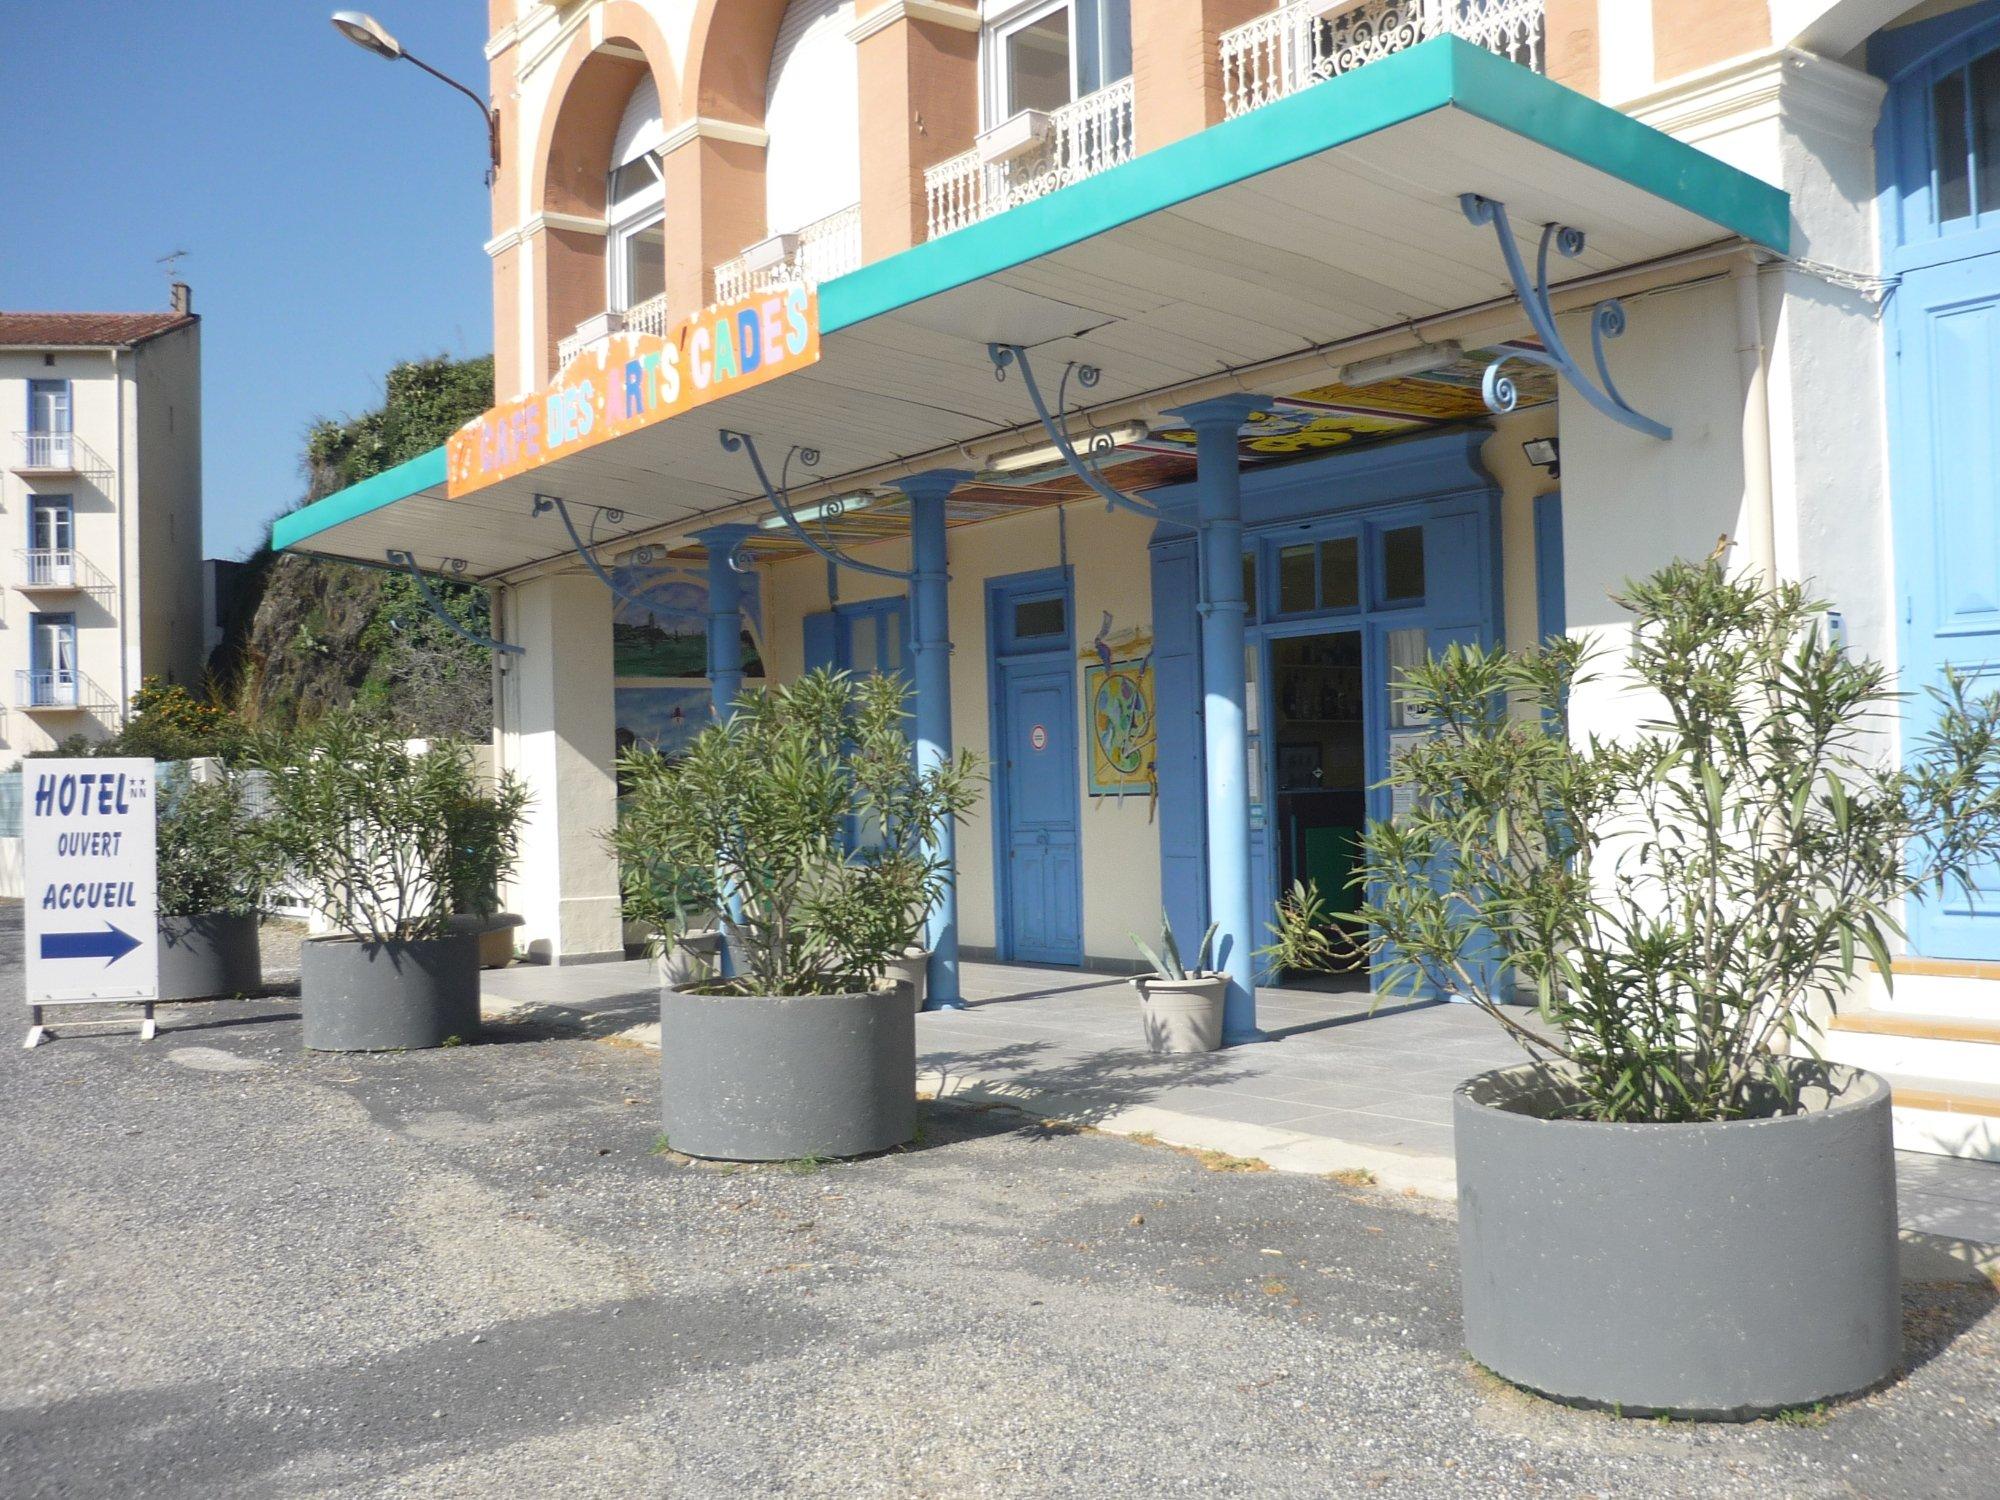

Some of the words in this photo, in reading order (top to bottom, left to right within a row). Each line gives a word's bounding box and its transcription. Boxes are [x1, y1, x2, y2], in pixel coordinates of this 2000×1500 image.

[547, 379, 594, 449] DES
[35, 773, 129, 816] HOTEL
[58, 831, 122, 857] OUVERT
[42, 881, 137, 909] ACCUEIL
